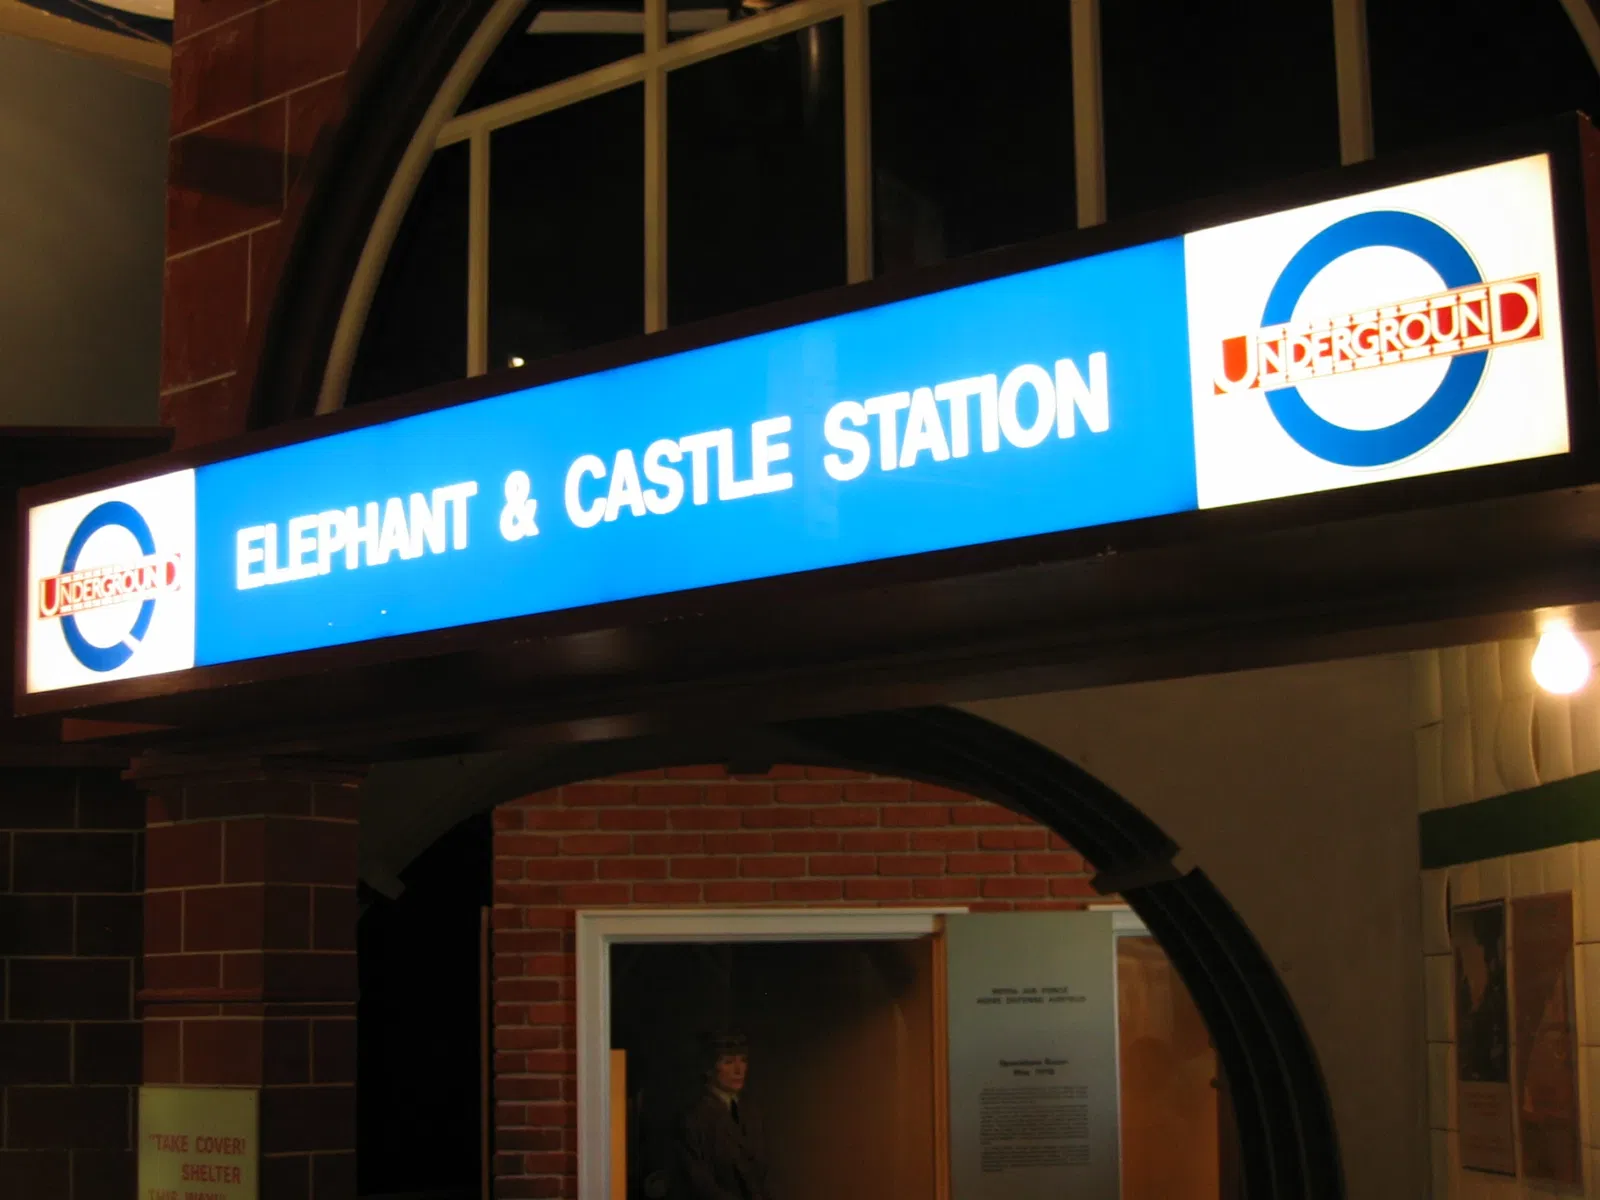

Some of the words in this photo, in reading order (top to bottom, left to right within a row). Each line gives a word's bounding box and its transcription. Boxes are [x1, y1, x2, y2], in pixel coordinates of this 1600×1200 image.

[1213, 277, 1541, 394] UNDERGROUND
[236, 481, 478, 590] ELEPHANT
[499, 470, 539, 542] &
[564, 415, 793, 528] CASTLE
[823, 352, 1110, 481] STATION
[39, 552, 181, 619] UNDERGROUND
[181, 1163, 242, 1184] SHELTER
[195, 1135, 246, 1155] COVER!
